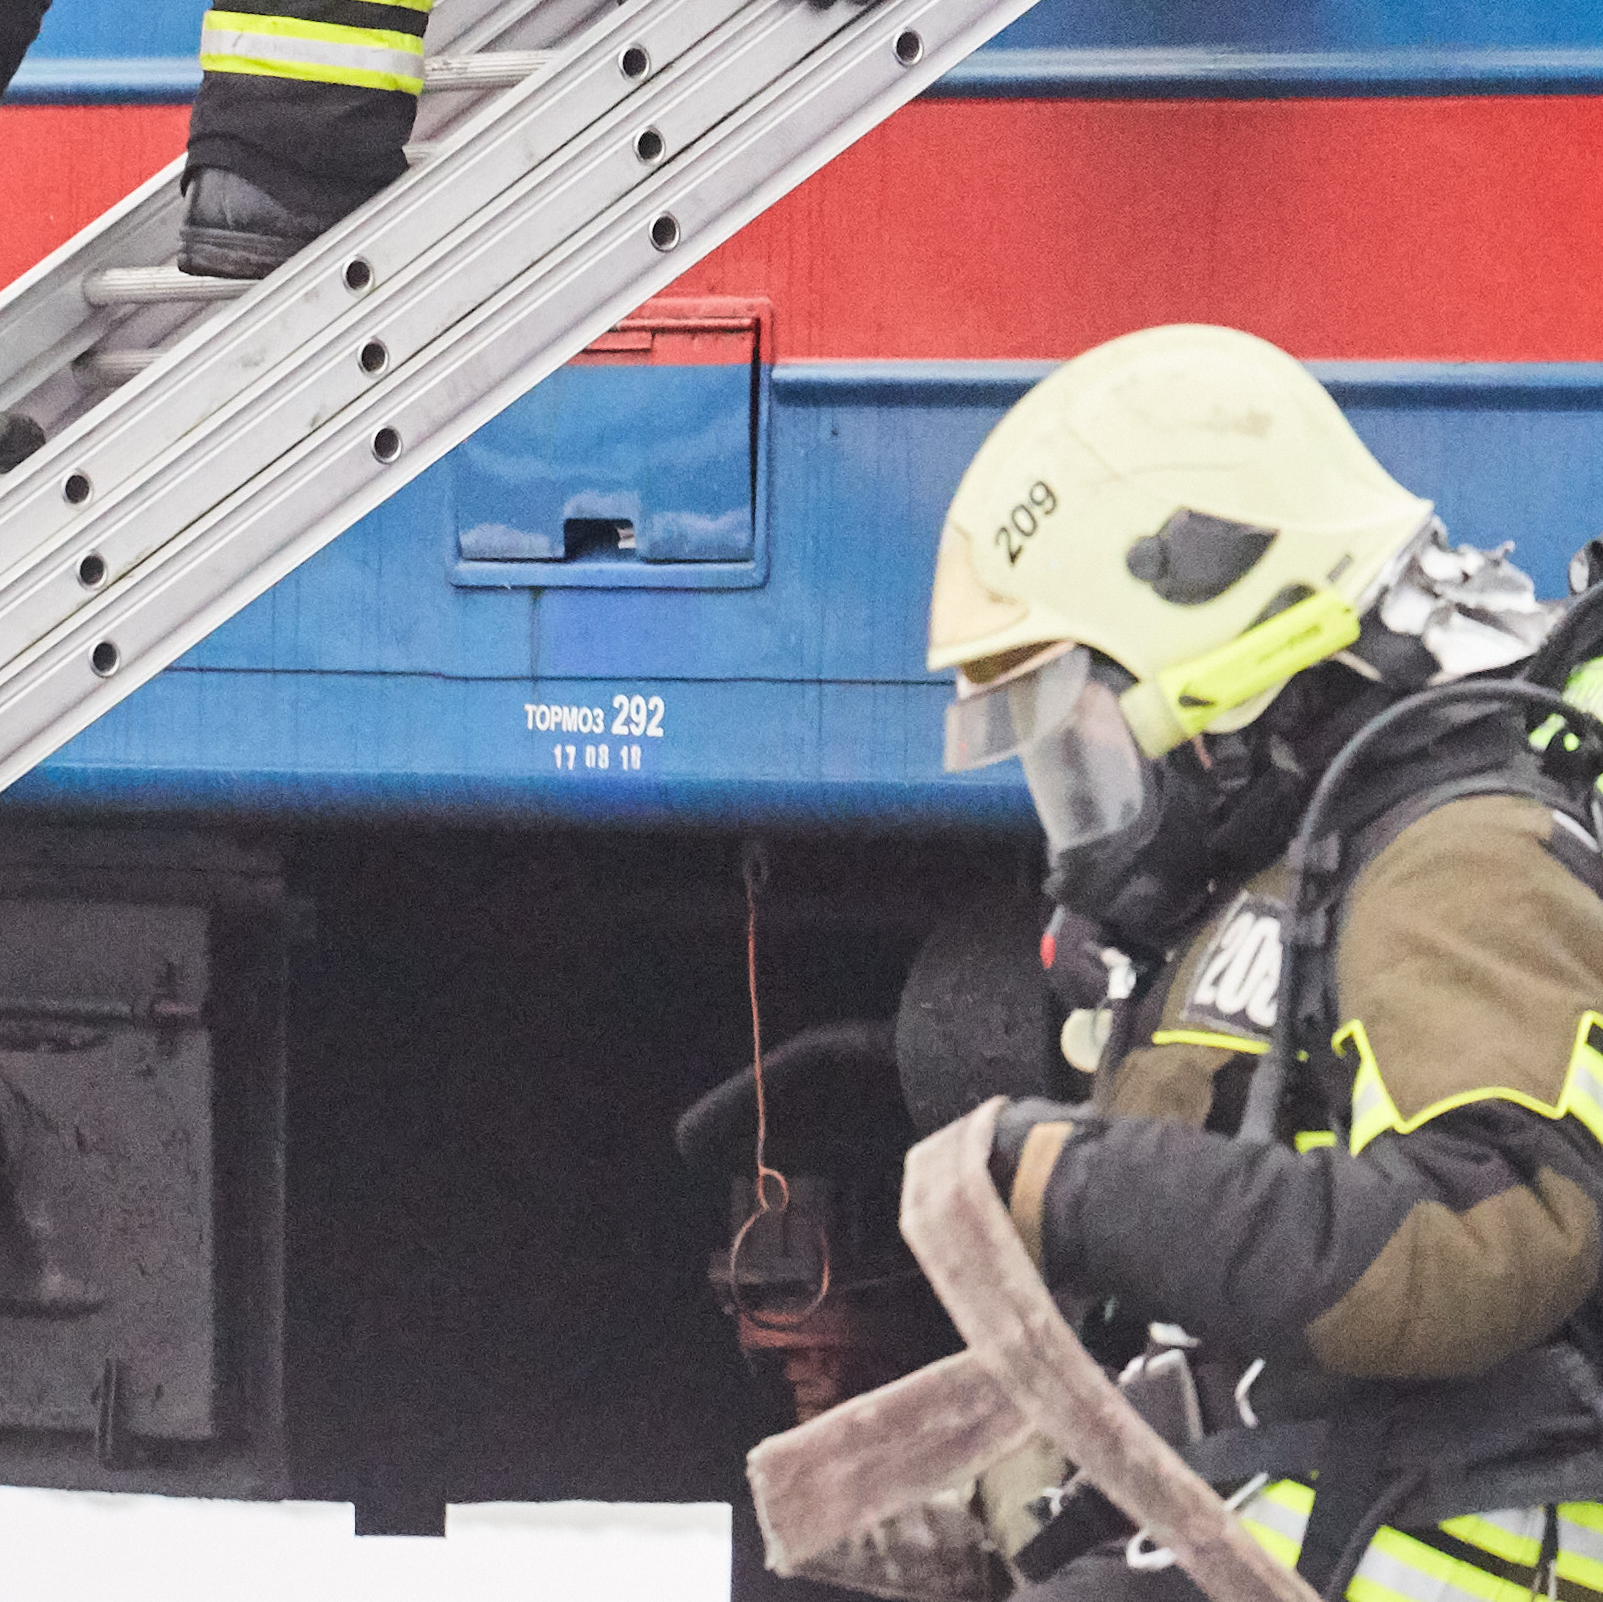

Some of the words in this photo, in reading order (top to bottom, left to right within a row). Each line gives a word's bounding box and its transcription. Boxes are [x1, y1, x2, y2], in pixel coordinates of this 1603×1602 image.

[995, 481, 1057, 565] 209
[524, 703, 604, 734] ТОРМОЗ
[611, 694, 665, 738] 292
[554, 743, 577, 771] 17
